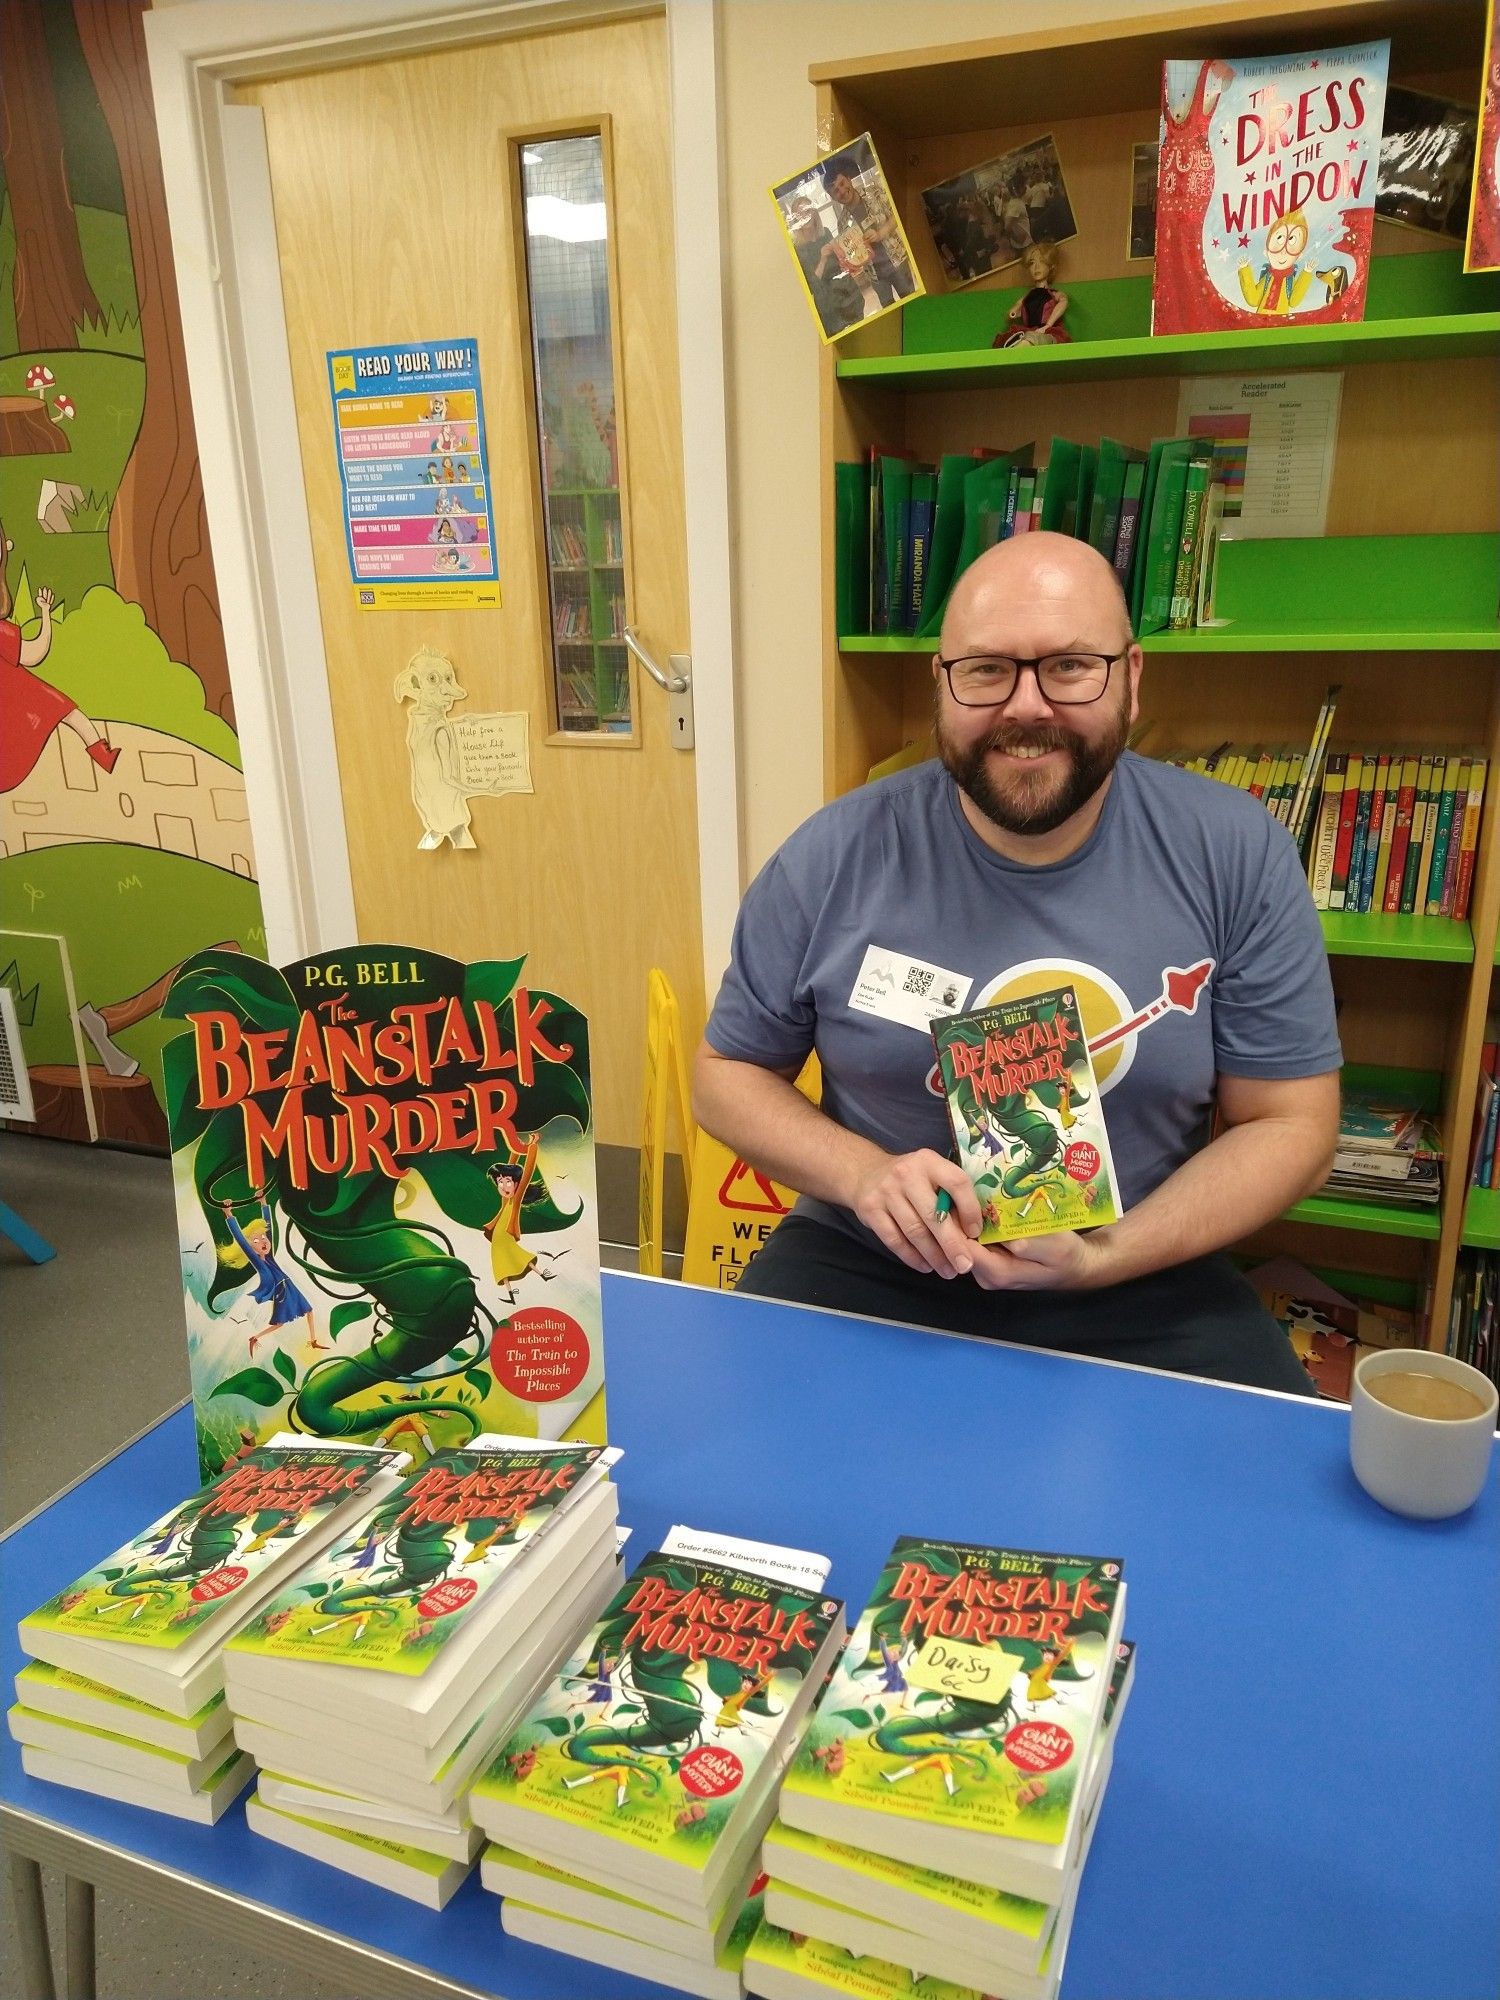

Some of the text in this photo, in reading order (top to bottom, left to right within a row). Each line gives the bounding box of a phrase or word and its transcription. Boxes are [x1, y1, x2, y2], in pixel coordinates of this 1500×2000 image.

[1237, 77, 1365, 166] DRESS
[1266, 141, 1325, 182] IN THE
[1222, 160, 1368, 233] WINDOW
[357, 348, 473, 377] READ YOUR WAY!
[1241, 381, 1286, 390] Accelerated
[912, 537, 924, 613] MIRANDA HART
[303, 961, 425, 987] P.G. BELL
[859, 982, 887, 997] Peter Bell
[317, 991, 360, 1025] The
[982, 1010, 1031, 1031] P.G. BELL
[186, 986, 574, 1110] BEANSTALK
[947, 1012, 1079, 1079] BEANSTALK
[969, 1049, 1071, 1106] MURDER
[239, 1079, 533, 1190] MURDER
[1070, 1149, 1099, 1161] GIANT
[1070, 1159, 1095, 1169] MURDER
[1067, 1164, 1093, 1178] MYSTERY
[732, 1221, 772, 1241] WE
[513, 1320, 567, 1331] Bestselling
[517, 1333, 565, 1344] author of
[506, 1348, 578, 1362] The Train to
[513, 1362, 571, 1380] Impossible
[526, 1379, 561, 1392] Places
[310, 1455, 342, 1464] BELL
[481, 1458, 543, 1468] P.G. BELL
[213, 1463, 368, 1494] BEANSTALK
[403, 1463, 576, 1498] BEANSTALK
[200, 1488, 327, 1518] MURDER
[395, 1491, 537, 1526] MURDER
[677, 1541, 702, 1552] Order
[702, 1545, 728, 1558] #5662
[729, 1551, 768, 1567] Kibworth
[769, 1559, 798, 1571] Books
[965, 1555, 1043, 1575] P.G. BELL
[1031, 1554, 1068, 1567] Impossible
[700, 1571, 771, 1600] P.G. BELL
[794, 1589, 815, 1600] Places
[890, 1562, 1111, 1619] BEANSTALK
[622, 1576, 817, 1651] BEANSTALK
[900, 1596, 1073, 1646] MURDER
[621, 1610, 778, 1678] MURDER
[927, 1646, 991, 1684] Daisy
[1022, 1727, 1071, 1752] GIANT
[1049, 1726, 1058, 1736] A
[723, 1754, 733, 1763] A
[1005, 1743, 1051, 1769] MYSTERY
[1015, 1738, 1060, 1760] MURDER
[681, 1763, 717, 1794] MYSTERY
[690, 1759, 726, 1787] MURDER
[700, 1752, 743, 1781] GIANT
[554, 1800, 599, 1824] Pounder,
[631, 1828, 660, 1843] Wonka
[972, 1814, 1006, 1828] Wonka
[951, 1889, 984, 1908] Wonka
[806, 1961, 841, 1981] Sibéal
